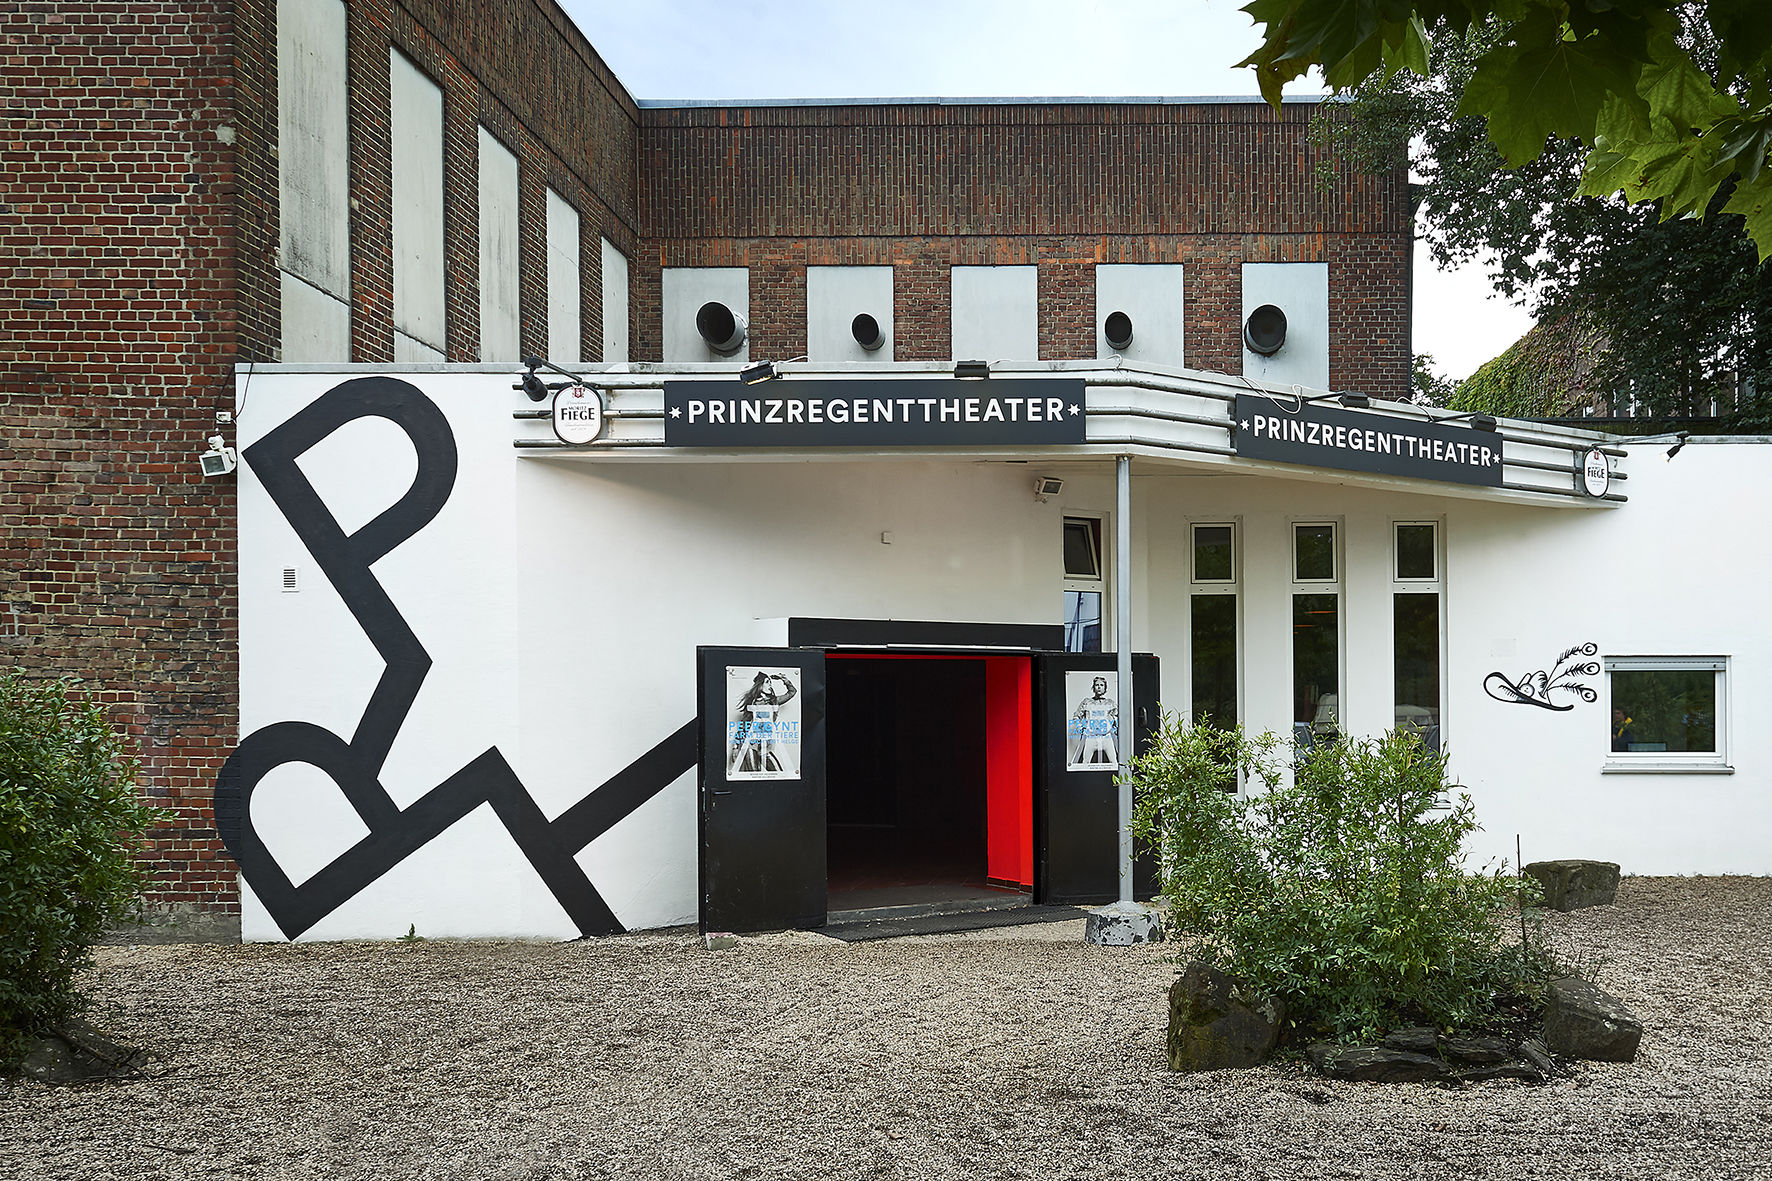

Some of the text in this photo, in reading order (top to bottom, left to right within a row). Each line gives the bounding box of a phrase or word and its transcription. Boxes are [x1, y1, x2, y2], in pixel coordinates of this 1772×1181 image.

[560, 407, 595, 420] FIEGE
[688, 398, 1064, 424] PRINZREGENTTHEATER
[1253, 414, 1492, 467] PRINZREGENTTHEATER
[1587, 466, 1605, 479] FIEGE
[729, 721, 799, 731] PEER GYNT
[728, 731, 753, 739] FARM
[776, 731, 799, 739] TIERE
